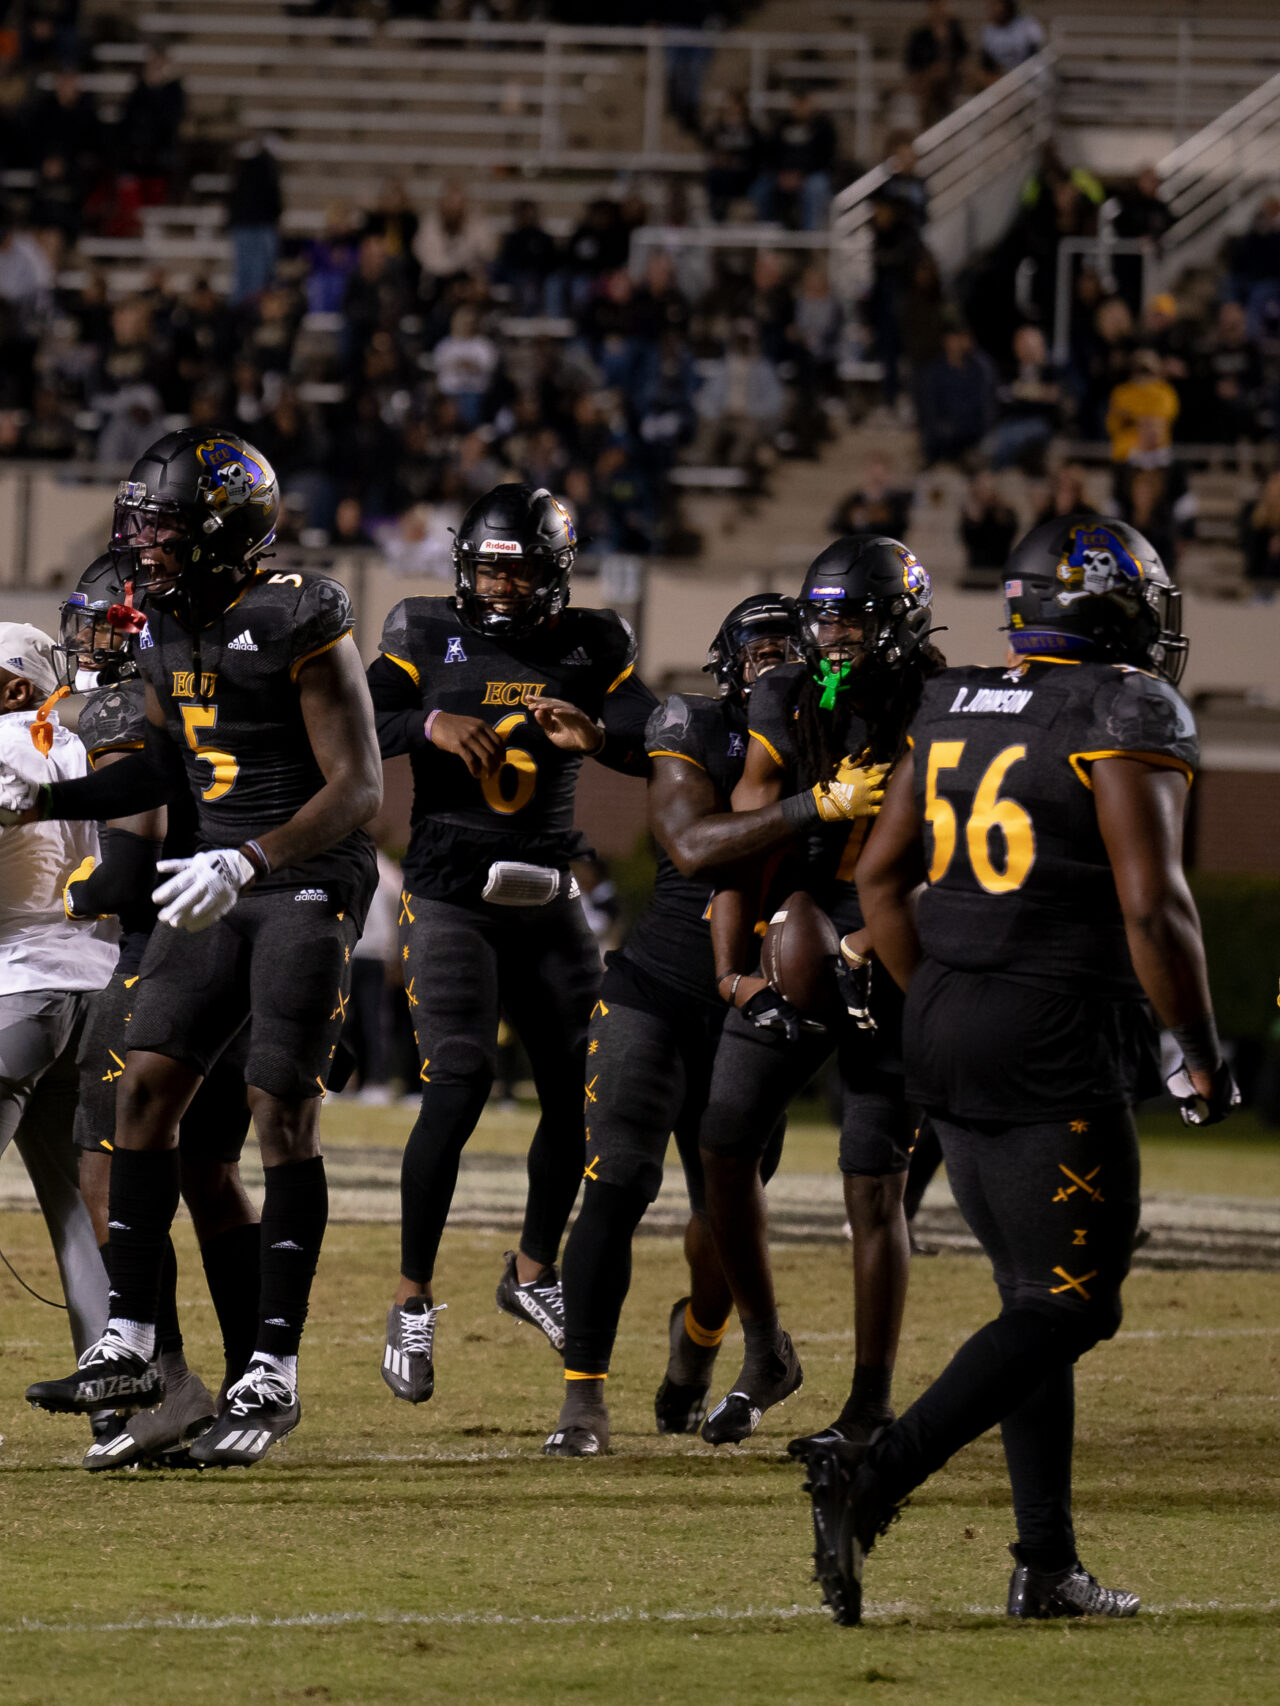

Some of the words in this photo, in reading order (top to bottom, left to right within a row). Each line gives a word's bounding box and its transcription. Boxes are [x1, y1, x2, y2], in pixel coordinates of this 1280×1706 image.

[485, 541, 516, 551] Riddell
[227, 641, 258, 652] adidas
[171, 671, 218, 698] ECU
[481, 681, 547, 706] ECU
[178, 702, 240, 801] 5
[480, 711, 539, 816] 6
[924, 738, 1037, 895] 56
[294, 892, 328, 902] adidas
